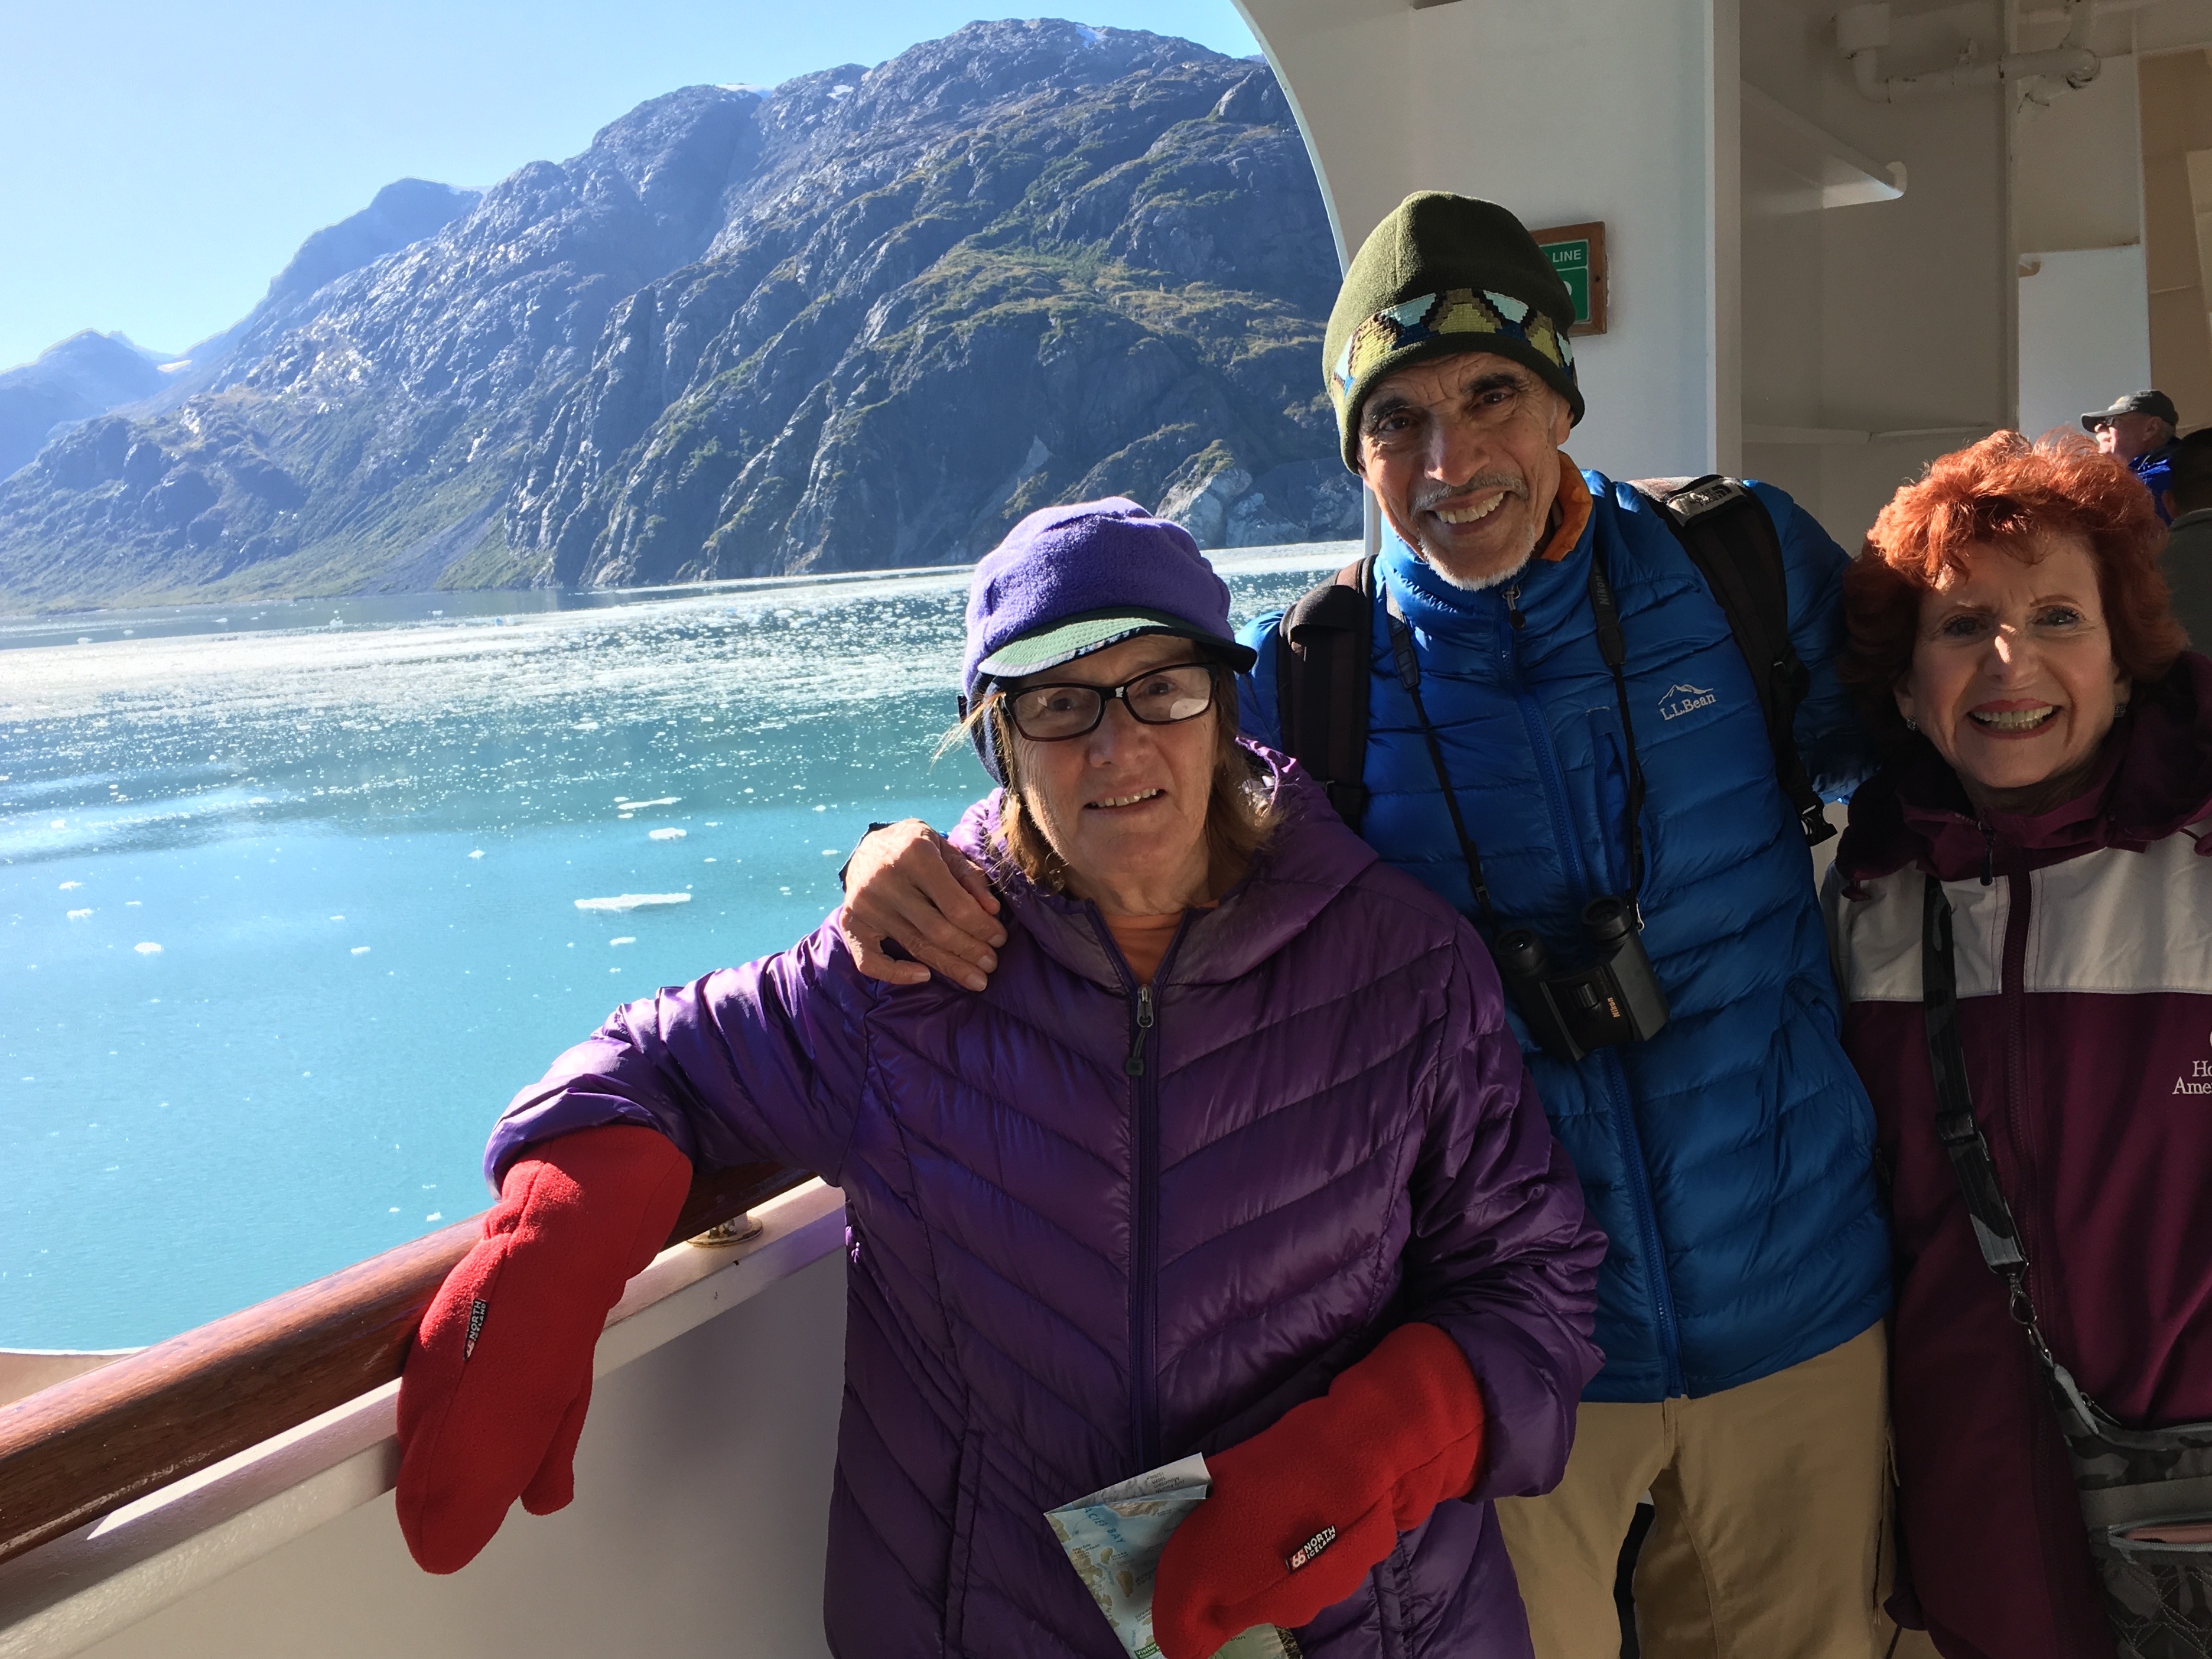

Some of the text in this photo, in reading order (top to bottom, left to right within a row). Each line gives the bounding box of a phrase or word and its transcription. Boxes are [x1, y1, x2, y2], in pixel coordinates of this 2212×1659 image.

[1552, 249, 1582, 263] LINE
[1595, 575, 1610, 605] Nikon
[1607, 997, 1621, 1017] Nikon
[2172, 1076, 2212, 1094] Ame
[469, 1300, 482, 1340] NORTH
[1107, 1528, 1126, 1543] BAY
[1292, 1525, 1336, 1567] 66 NORTH
[1307, 1534, 1336, 1559] ICELAND
[1136, 1643, 1156, 1655] Visitor
